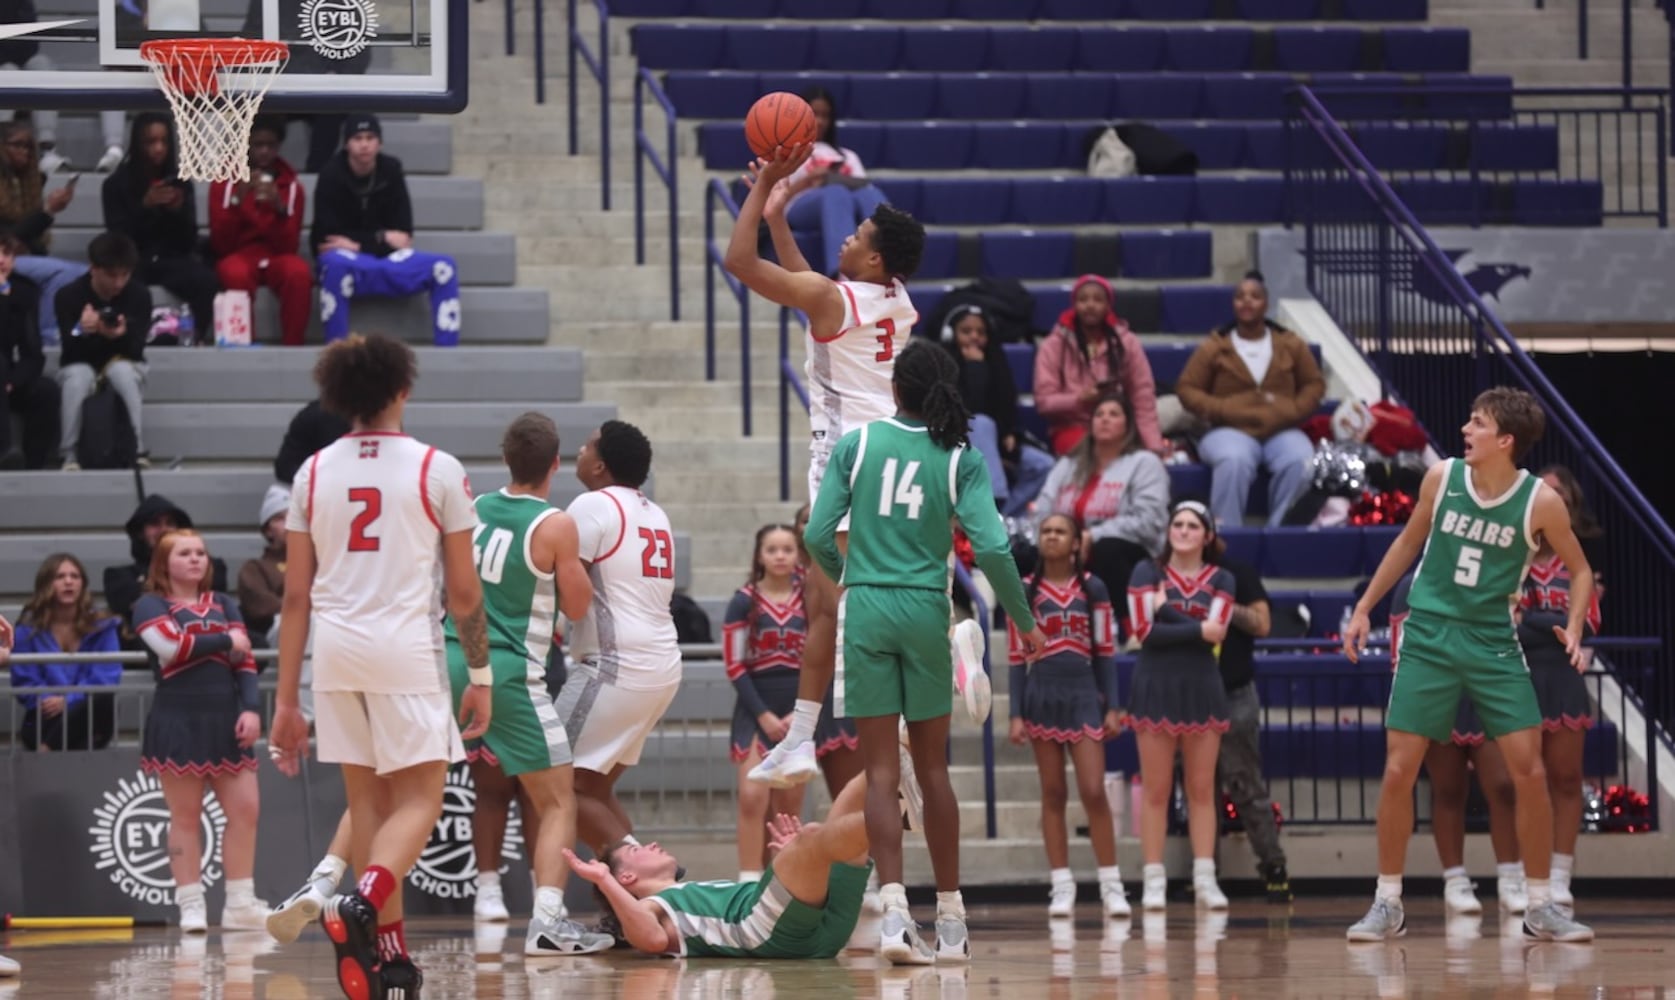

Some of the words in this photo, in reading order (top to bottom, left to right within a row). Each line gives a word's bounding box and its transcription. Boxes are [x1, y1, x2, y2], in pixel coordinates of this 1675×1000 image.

[318, 11, 360, 26] EYBL
[309, 36, 370, 60] SCHOLASTIC
[876, 317, 896, 363] 3
[878, 457, 925, 520] 14
[347, 487, 382, 552] 2
[1441, 509, 1516, 548] BEARS
[638, 526, 674, 579] 23
[1454, 545, 1483, 588] 5
[430, 815, 474, 842] YB
[110, 864, 222, 905] SCHOLIC
